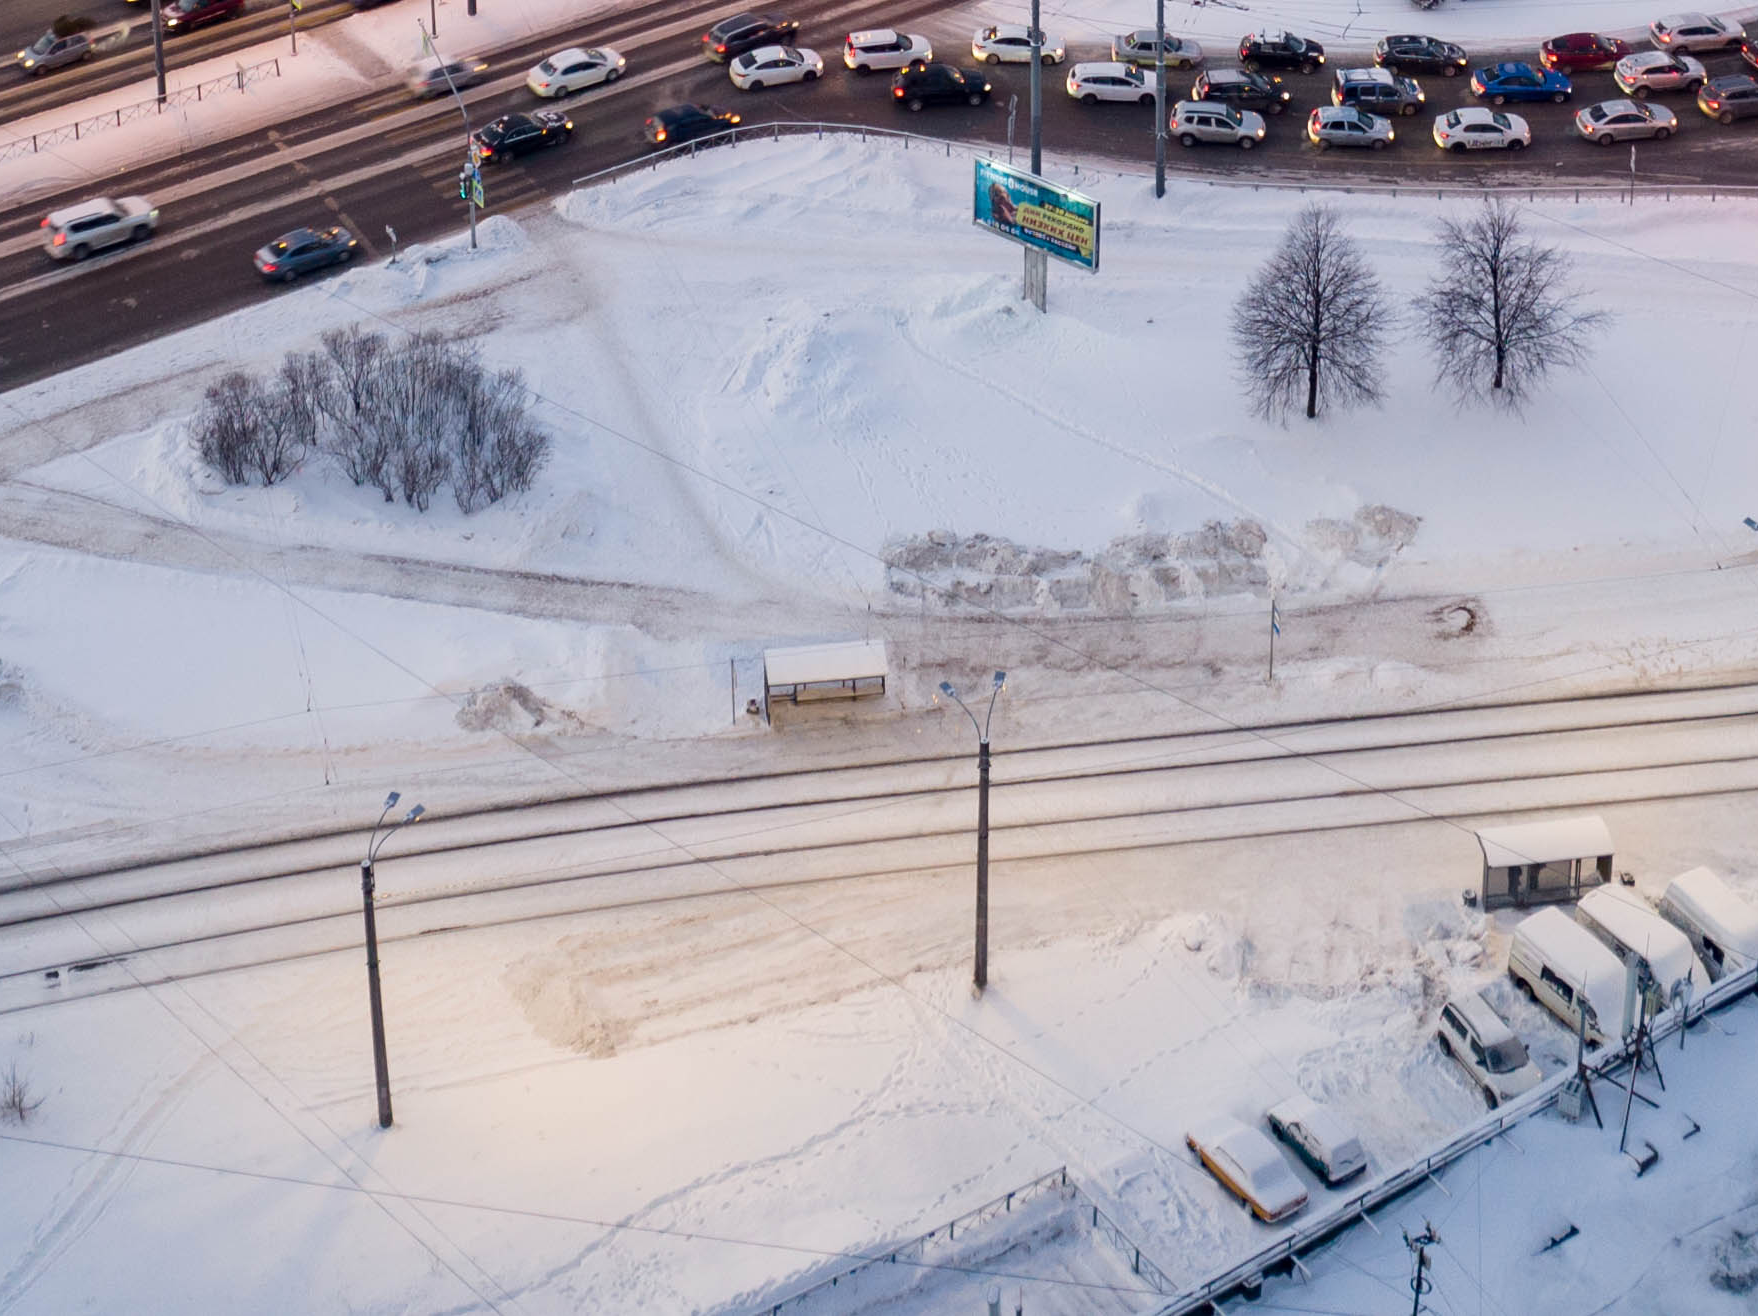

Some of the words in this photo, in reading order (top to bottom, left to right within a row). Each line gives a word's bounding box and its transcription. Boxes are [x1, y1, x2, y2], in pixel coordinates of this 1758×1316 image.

[1022, 215, 1065, 238] НИЗКИХ
[1067, 231, 1089, 246] ЦЕН
[1042, 212, 1085, 233] РЕКОРДНО
